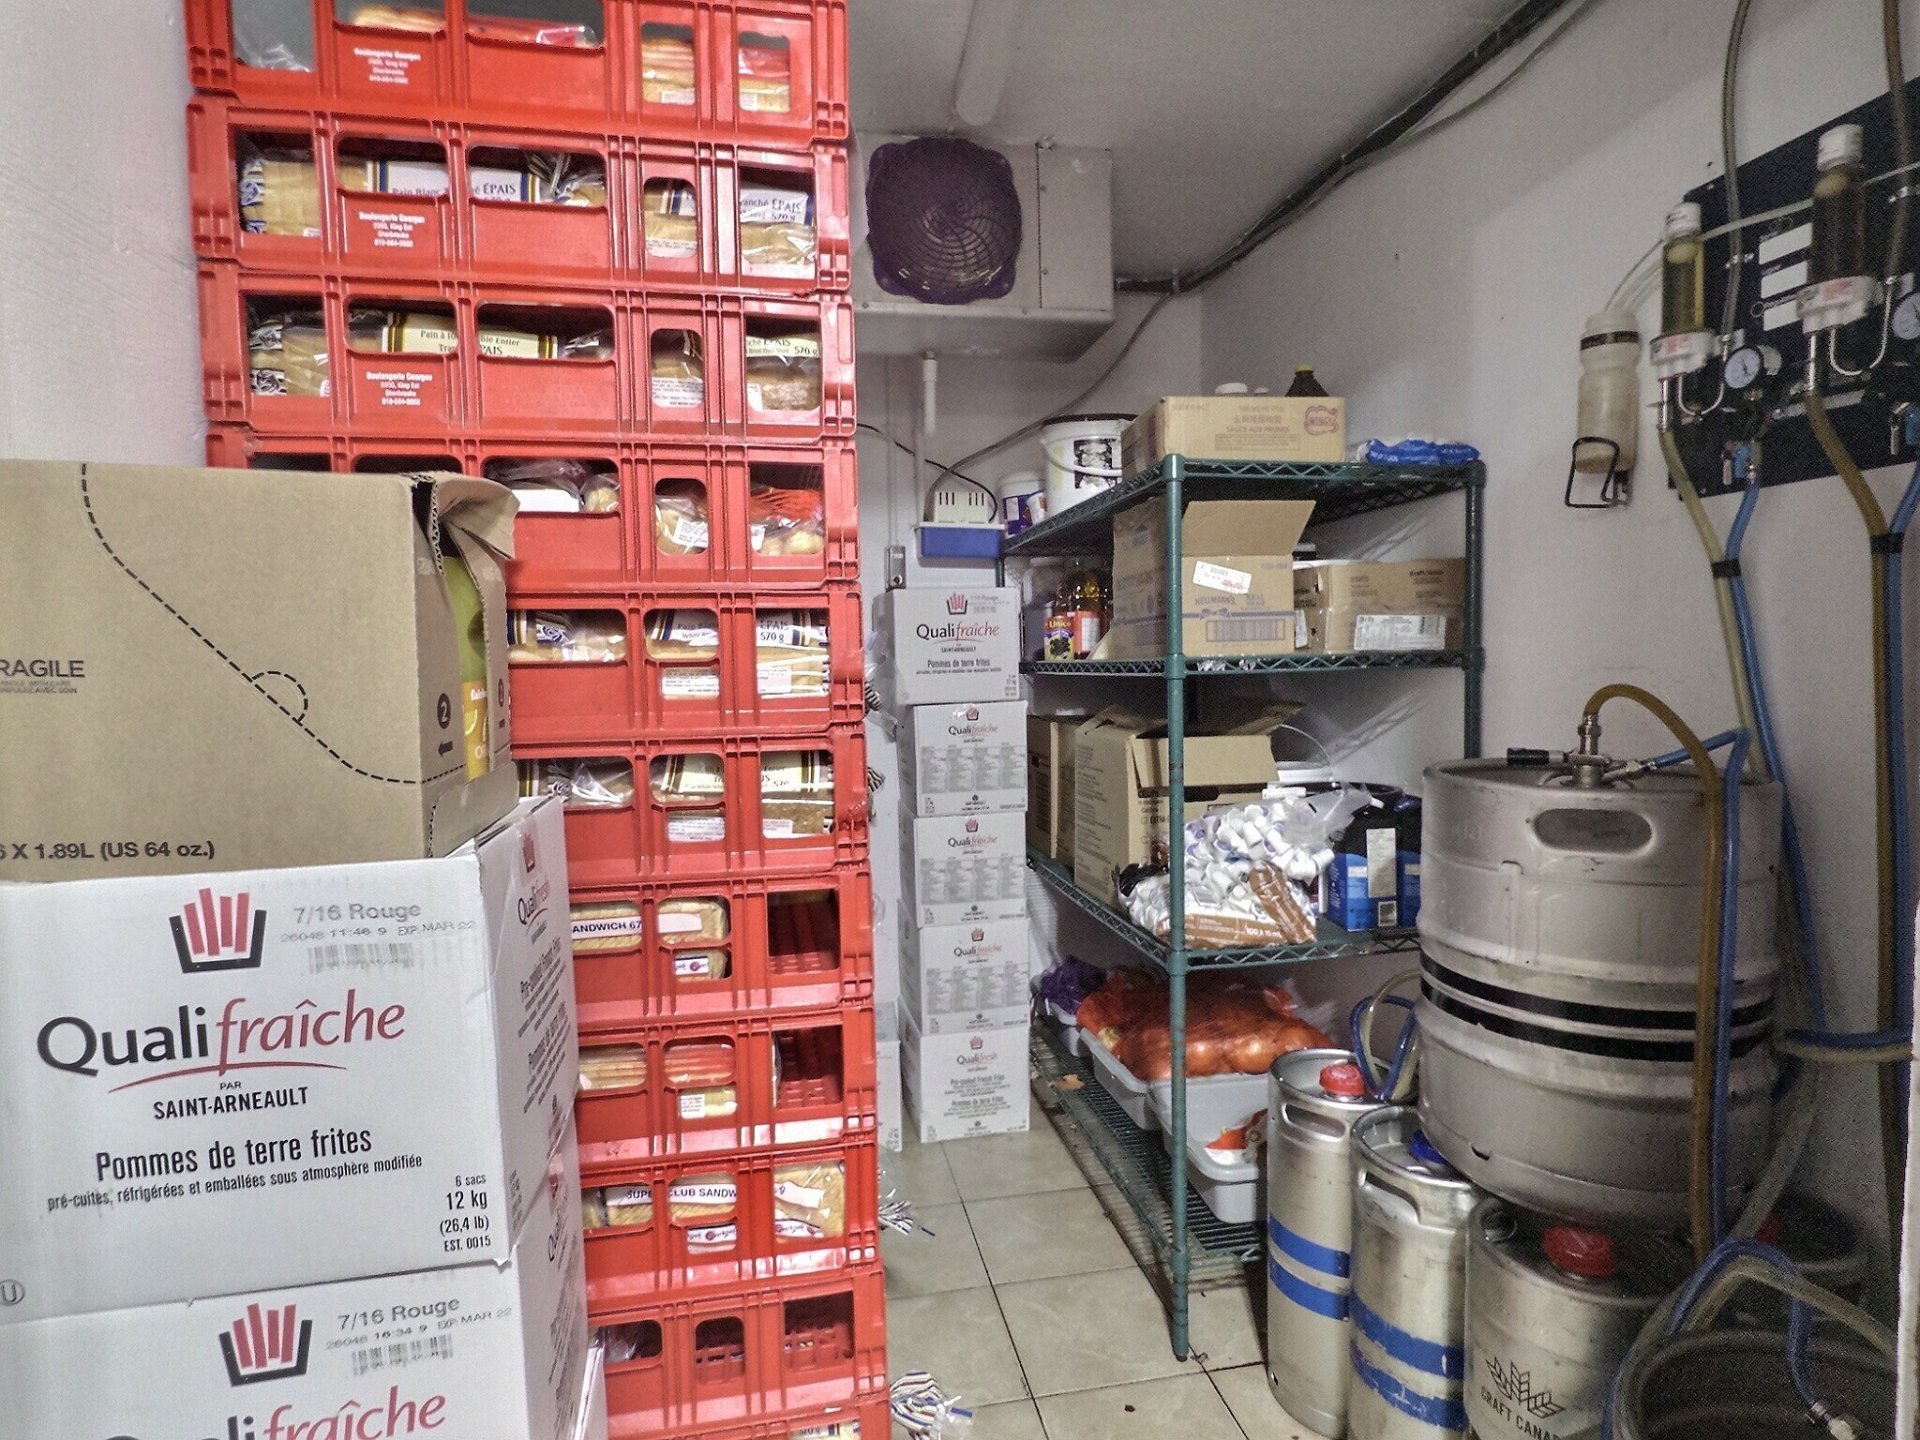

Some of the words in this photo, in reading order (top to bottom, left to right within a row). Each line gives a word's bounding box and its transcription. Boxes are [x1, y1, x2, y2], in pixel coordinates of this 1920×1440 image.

[483, 183, 516, 194] ÉPAIS
[740, 199, 768, 208] ranché
[420, 330, 439, 339] Pain
[495, 336, 520, 346] Entier
[480, 345, 503, 355] PAIS
[794, 345, 810, 354] 570
[760, 631, 776, 641] 570
[916, 620, 1000, 641] Qualifraîche
[0, 659, 85, 678] RAGILE
[12, 843, 28, 860] X
[34, 842, 94, 860] 1.89L
[101, 842, 139, 861] (US
[144, 841, 171, 858] 64
[176, 840, 215, 860] oz.)
[293, 904, 342, 925] 7/16
[348, 902, 422, 923] Rouge
[572, 921, 626, 934] ANDWICH
[36, 988, 405, 1077] Qualifraîche
[219, 1081, 242, 1091] PAR
[153, 1086, 309, 1120] SAINT-ARNEAULT
[96, 1149, 199, 1182] Pommes
[208, 1140, 236, 1171] de
[245, 1137, 302, 1166] terre
[310, 1127, 372, 1158] frites
[47, 1190, 114, 1213] pré-cuites,
[117, 1182, 185, 1203] réfrigérées
[189, 1180, 201, 1195] et
[205, 1172, 266, 1194] emballées
[270, 1171, 298, 1186] sous
[302, 1161, 369, 1182] atmosphère
[374, 1154, 422, 1173] modifiée
[455, 1175, 462, 1187] 6
[465, 1174, 487, 1186] sacs
[446, 1190, 465, 1210] 12
[471, 1189, 488, 1210] kg
[699, 1186, 737, 1197] SANDW
[440, 1216, 470, 1237] (26,4
[474, 1215, 490, 1231] lb)
[444, 1238, 463, 1252] EST.
[466, 1235, 492, 1250] 0015
[337, 1309, 385, 1331] 7/16
[392, 1298, 460, 1322] Rouge
[1481, 1386, 1513, 1421] CRAFT
